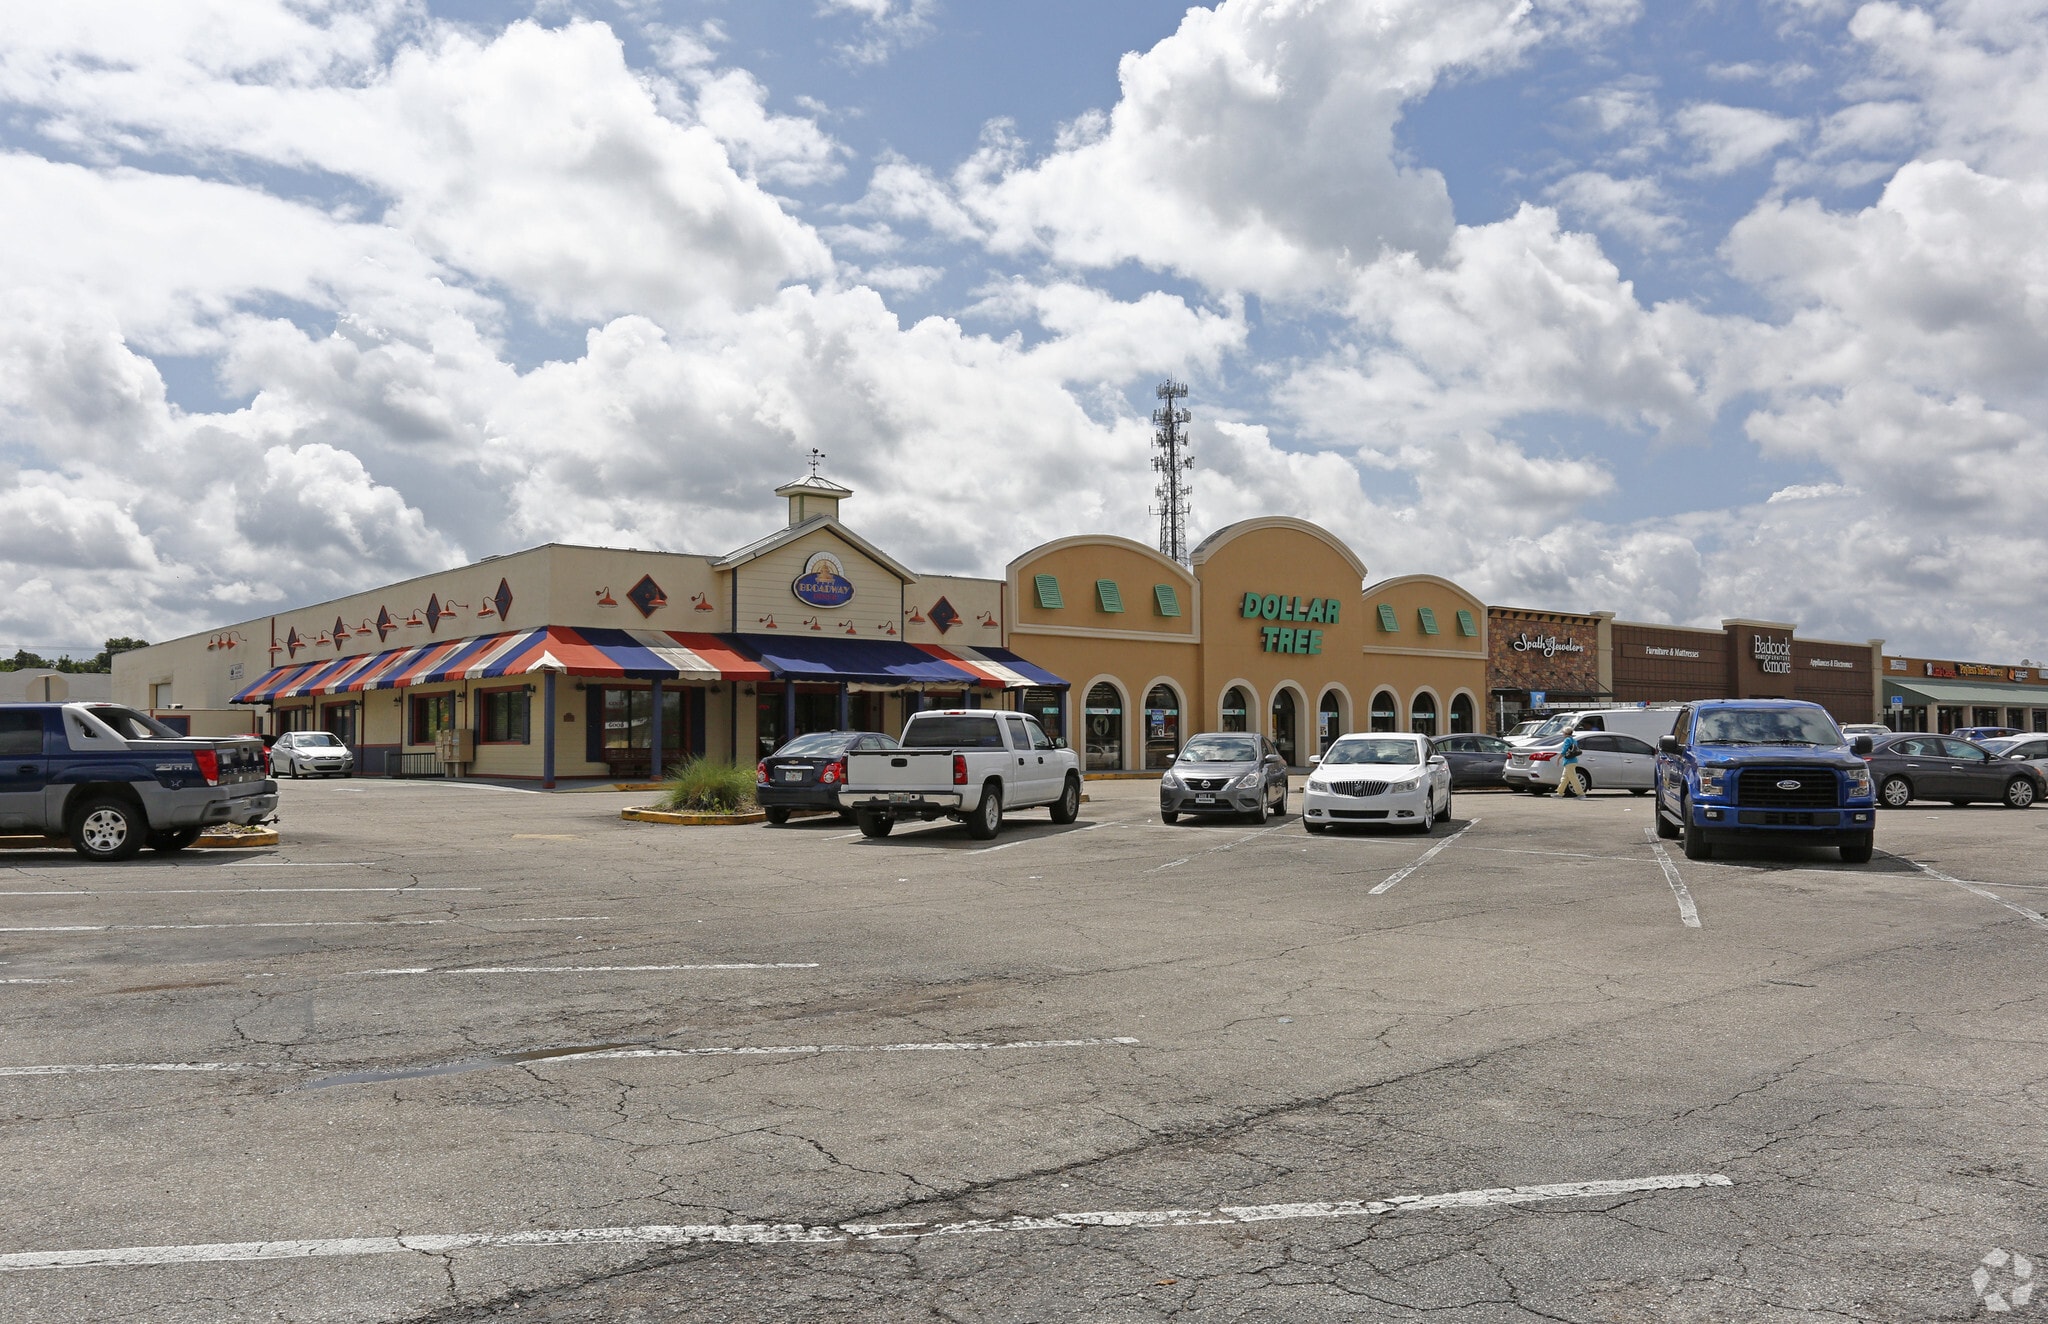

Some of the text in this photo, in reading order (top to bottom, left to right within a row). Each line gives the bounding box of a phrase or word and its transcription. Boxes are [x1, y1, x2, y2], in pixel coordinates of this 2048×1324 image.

[799, 583, 849, 595] BROADWAY
[1242, 591, 1341, 624] DOLLAR
[1262, 626, 1324, 655] TREE
[1513, 632, 1584, 658] Spath Jewelers
[1754, 634, 1791, 656] Badcock
[1645, 646, 1700, 658] Furniture & Mattresses
[1809, 658, 1830, 667] Appliances
[1833, 660, 1854, 668] Electronics
